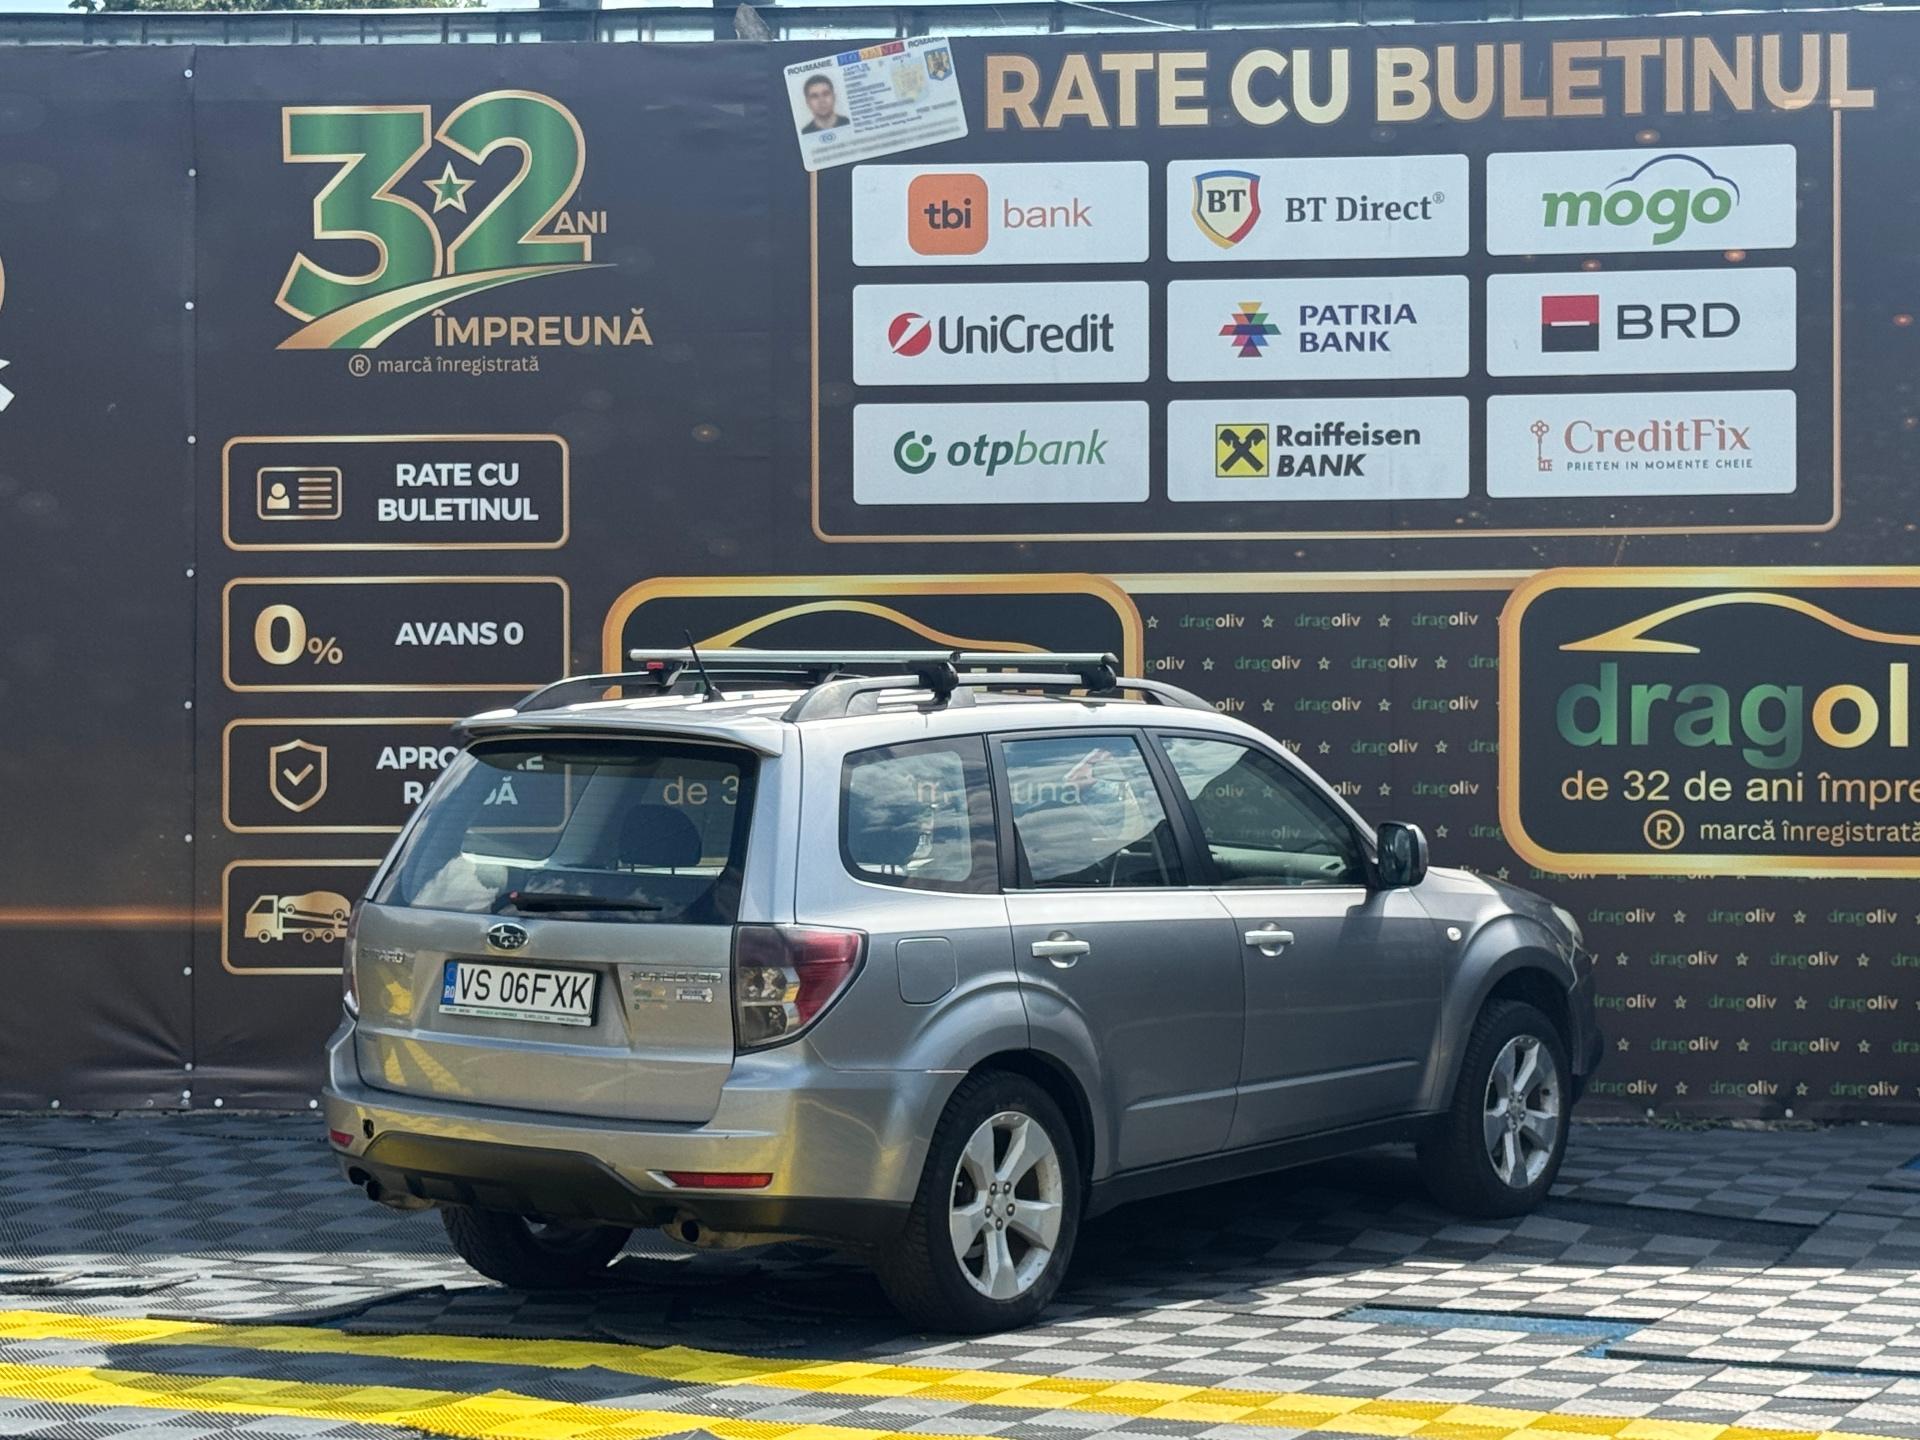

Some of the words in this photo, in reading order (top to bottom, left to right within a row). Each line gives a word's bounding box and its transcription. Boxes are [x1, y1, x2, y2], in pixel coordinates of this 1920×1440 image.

[987, 52, 1208, 128] RATE
[1231, 49, 1349, 125] CU
[1377, 34, 1875, 121] BULETINUL
[1207, 190, 1246, 212] BT
[1286, 197, 1326, 222] BT
[554, 211, 607, 235] ANI
[924, 198, 971, 229] tbi
[1004, 198, 1092, 228] bank
[1543, 187, 1732, 245] mogo
[1300, 304, 1417, 326] PATRIA
[1617, 303, 1740, 340] BRD
[432, 307, 653, 347] ÎMPREUNĂ
[939, 314, 1114, 354] UniCredit
[1300, 331, 1390, 352] BANK
[378, 357, 432, 372] marcă
[437, 356, 539, 376] înregistrată
[1277, 422, 1420, 446] Raiffeisen
[1565, 419, 1750, 453] CreditFix
[947, 429, 1107, 476] otpbank
[397, 463, 472, 486] RATE
[478, 463, 519, 486] CU
[1277, 454, 1366, 477] BANK
[1567, 461, 1619, 471] PRIETEN
[1626, 461, 1638, 470] IN
[1645, 460, 1708, 469] MOMENTE
[1716, 459, 1752, 468] CHEIE
[378, 498, 538, 521] BULETINUL
[1179, 613, 1245, 631] dragoliv
[1294, 612, 1361, 631] dragoliv
[1411, 611, 1479, 629] dragoliv
[395, 622, 497, 645] AVANS
[504, 622, 523, 645] 0
[1146, 656, 1186, 674] goliv
[1234, 655, 1302, 673] dragoliv
[1350, 654, 1419, 672] dragoliv
[1294, 696, 1361, 715] dragoliv
[1411, 695, 1480, 714] dragoliv
[1350, 738, 1419, 756] dragoliv
[663, 775, 708, 805] de
[722, 775, 739, 805] 3
[1411, 780, 1480, 799] dragoliv
[1562, 770, 1608, 800] de
[1624, 770, 1669, 800] 32
[1684, 771, 1731, 801] de
[1746, 772, 1803, 802] ani
[1701, 820, 1776, 840] marcă
[1588, 908, 1656, 926] dragoliv
[1707, 908, 1776, 926] dragoliv
[1828, 908, 1897, 927] dragoliv
[1650, 950, 1719, 969] dragoliv
[1770, 951, 1839, 970] dragoliv
[459, 966, 493, 1002] VS
[500, 971, 590, 1010] 06FXK
[1709, 993, 1777, 1012] dragoliv
[1829, 994, 1899, 1013] dragoliv
[1651, 1036, 1719, 1054] dragoliv
[1772, 1037, 1840, 1056] dragoliv
[1590, 1079, 1658, 1098] dragoliv
[1710, 1079, 1779, 1098] dragoliv
[1830, 1081, 1900, 1100] dragoliv
